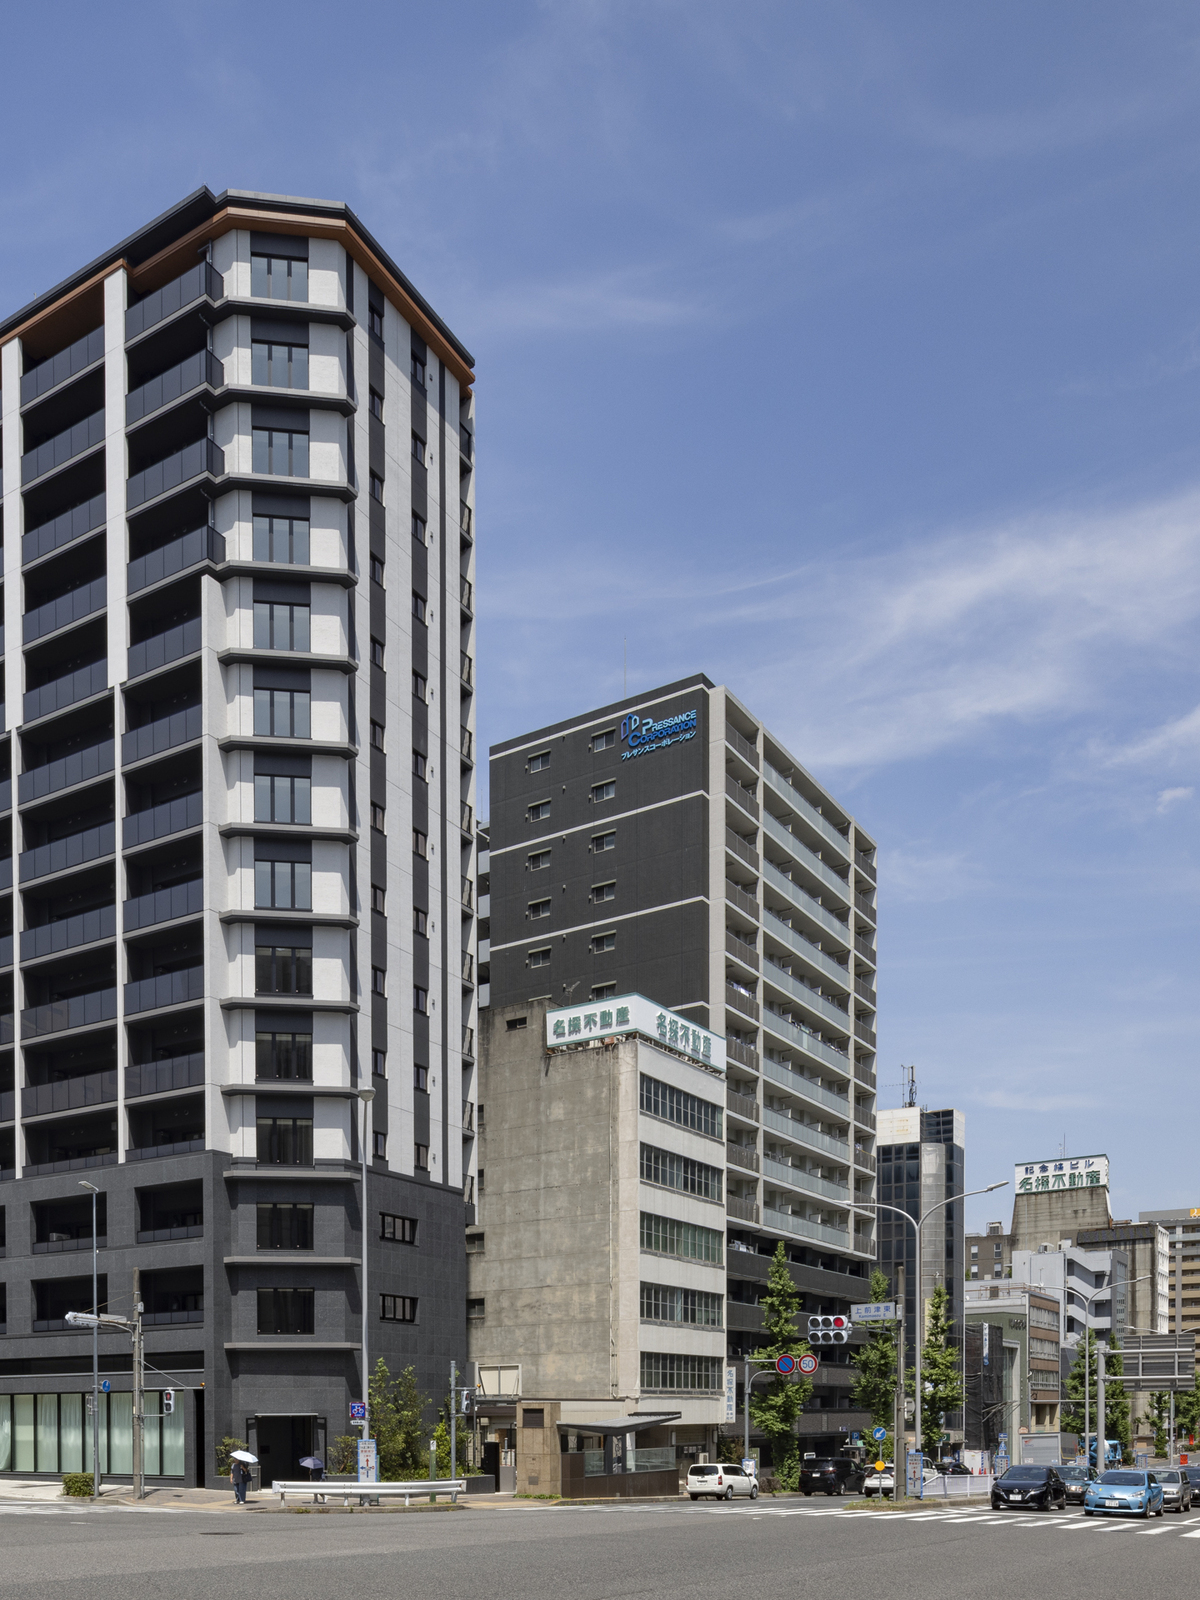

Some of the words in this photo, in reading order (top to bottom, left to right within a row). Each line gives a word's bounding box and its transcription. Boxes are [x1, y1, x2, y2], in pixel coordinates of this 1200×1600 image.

[628, 719, 697, 747] CORPORATION
[642, 709, 697, 735] PRESSANCE
[621, 731, 697, 760] プレサンスコーポレーション
[855, 1305, 891, 1315] 上前津東
[802, 1359, 814, 1369] 50
